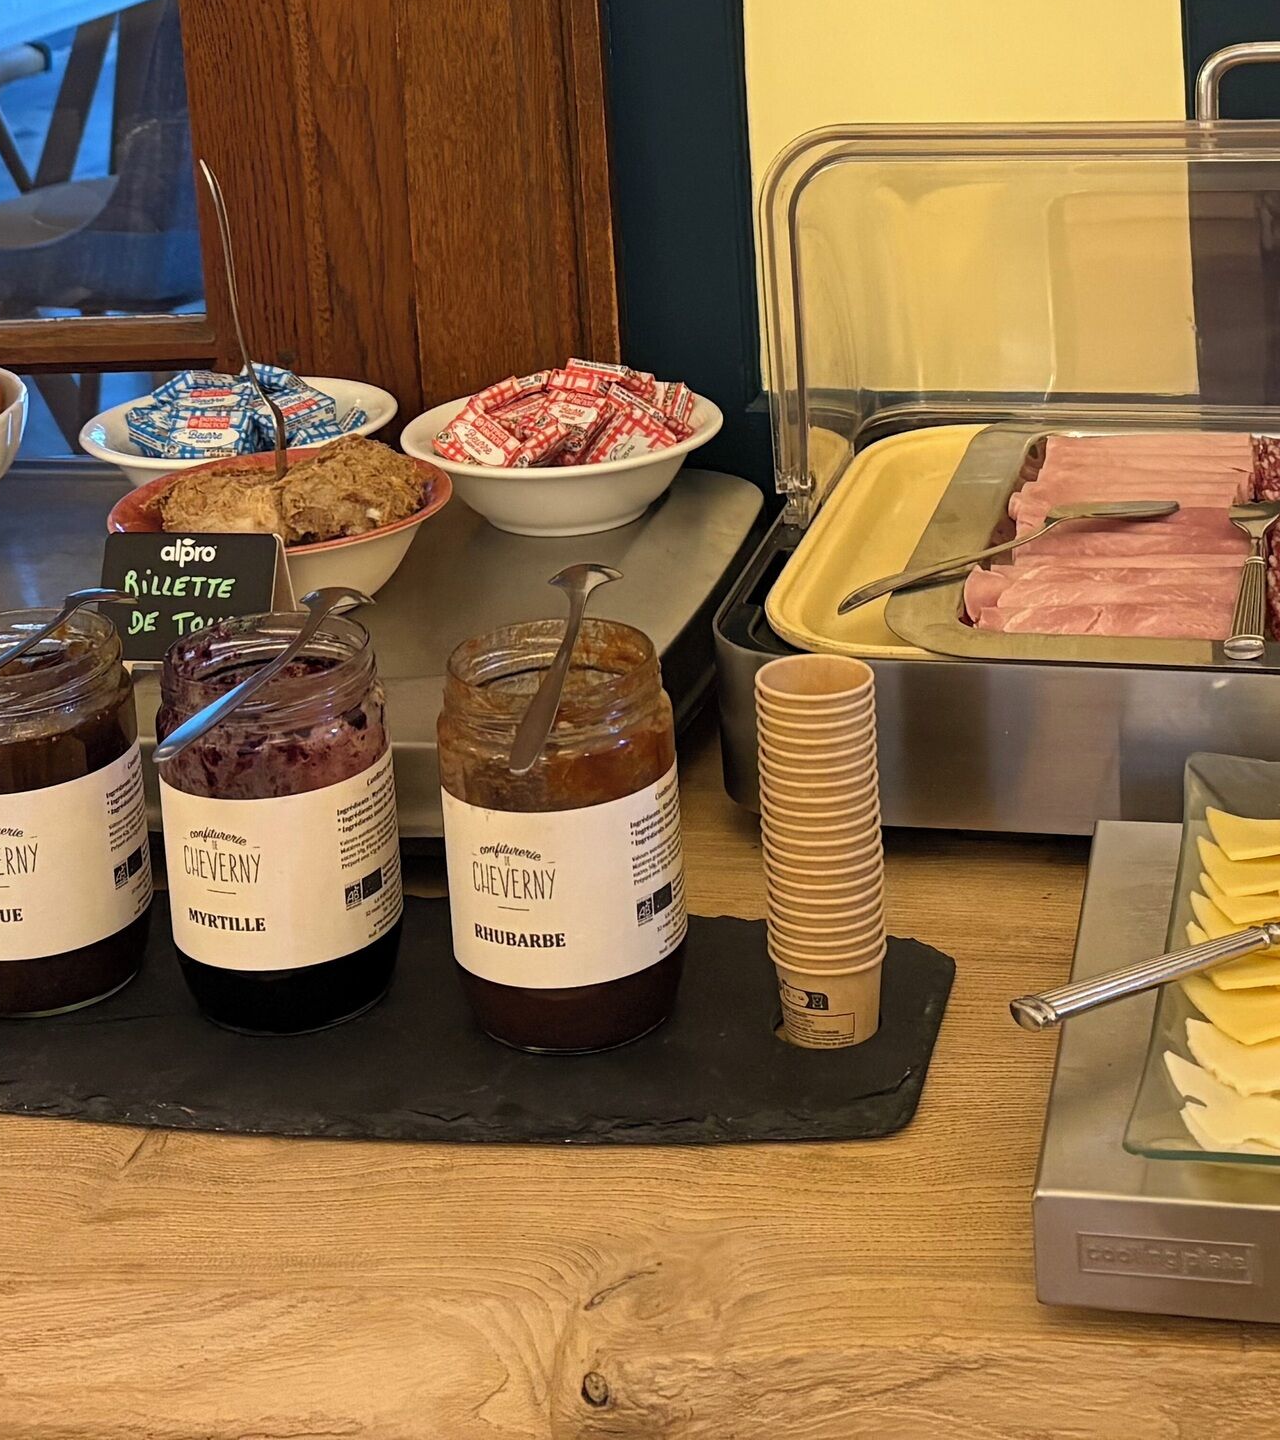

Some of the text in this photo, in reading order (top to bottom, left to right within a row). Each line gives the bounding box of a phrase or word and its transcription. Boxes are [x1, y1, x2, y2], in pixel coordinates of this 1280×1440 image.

[188, 429, 223, 440] Beurre
[160, 538, 217, 567] alpro
[127, 610, 160, 635] DE
[189, 826, 247, 847] confiturerie
[183, 844, 261, 884] CHEVERNY
[479, 842, 542, 862] confiturerie
[472, 861, 556, 900] CHEVERNY
[188, 907, 267, 932] MYRTILLE
[474, 922, 567, 949] RHUBARBE
